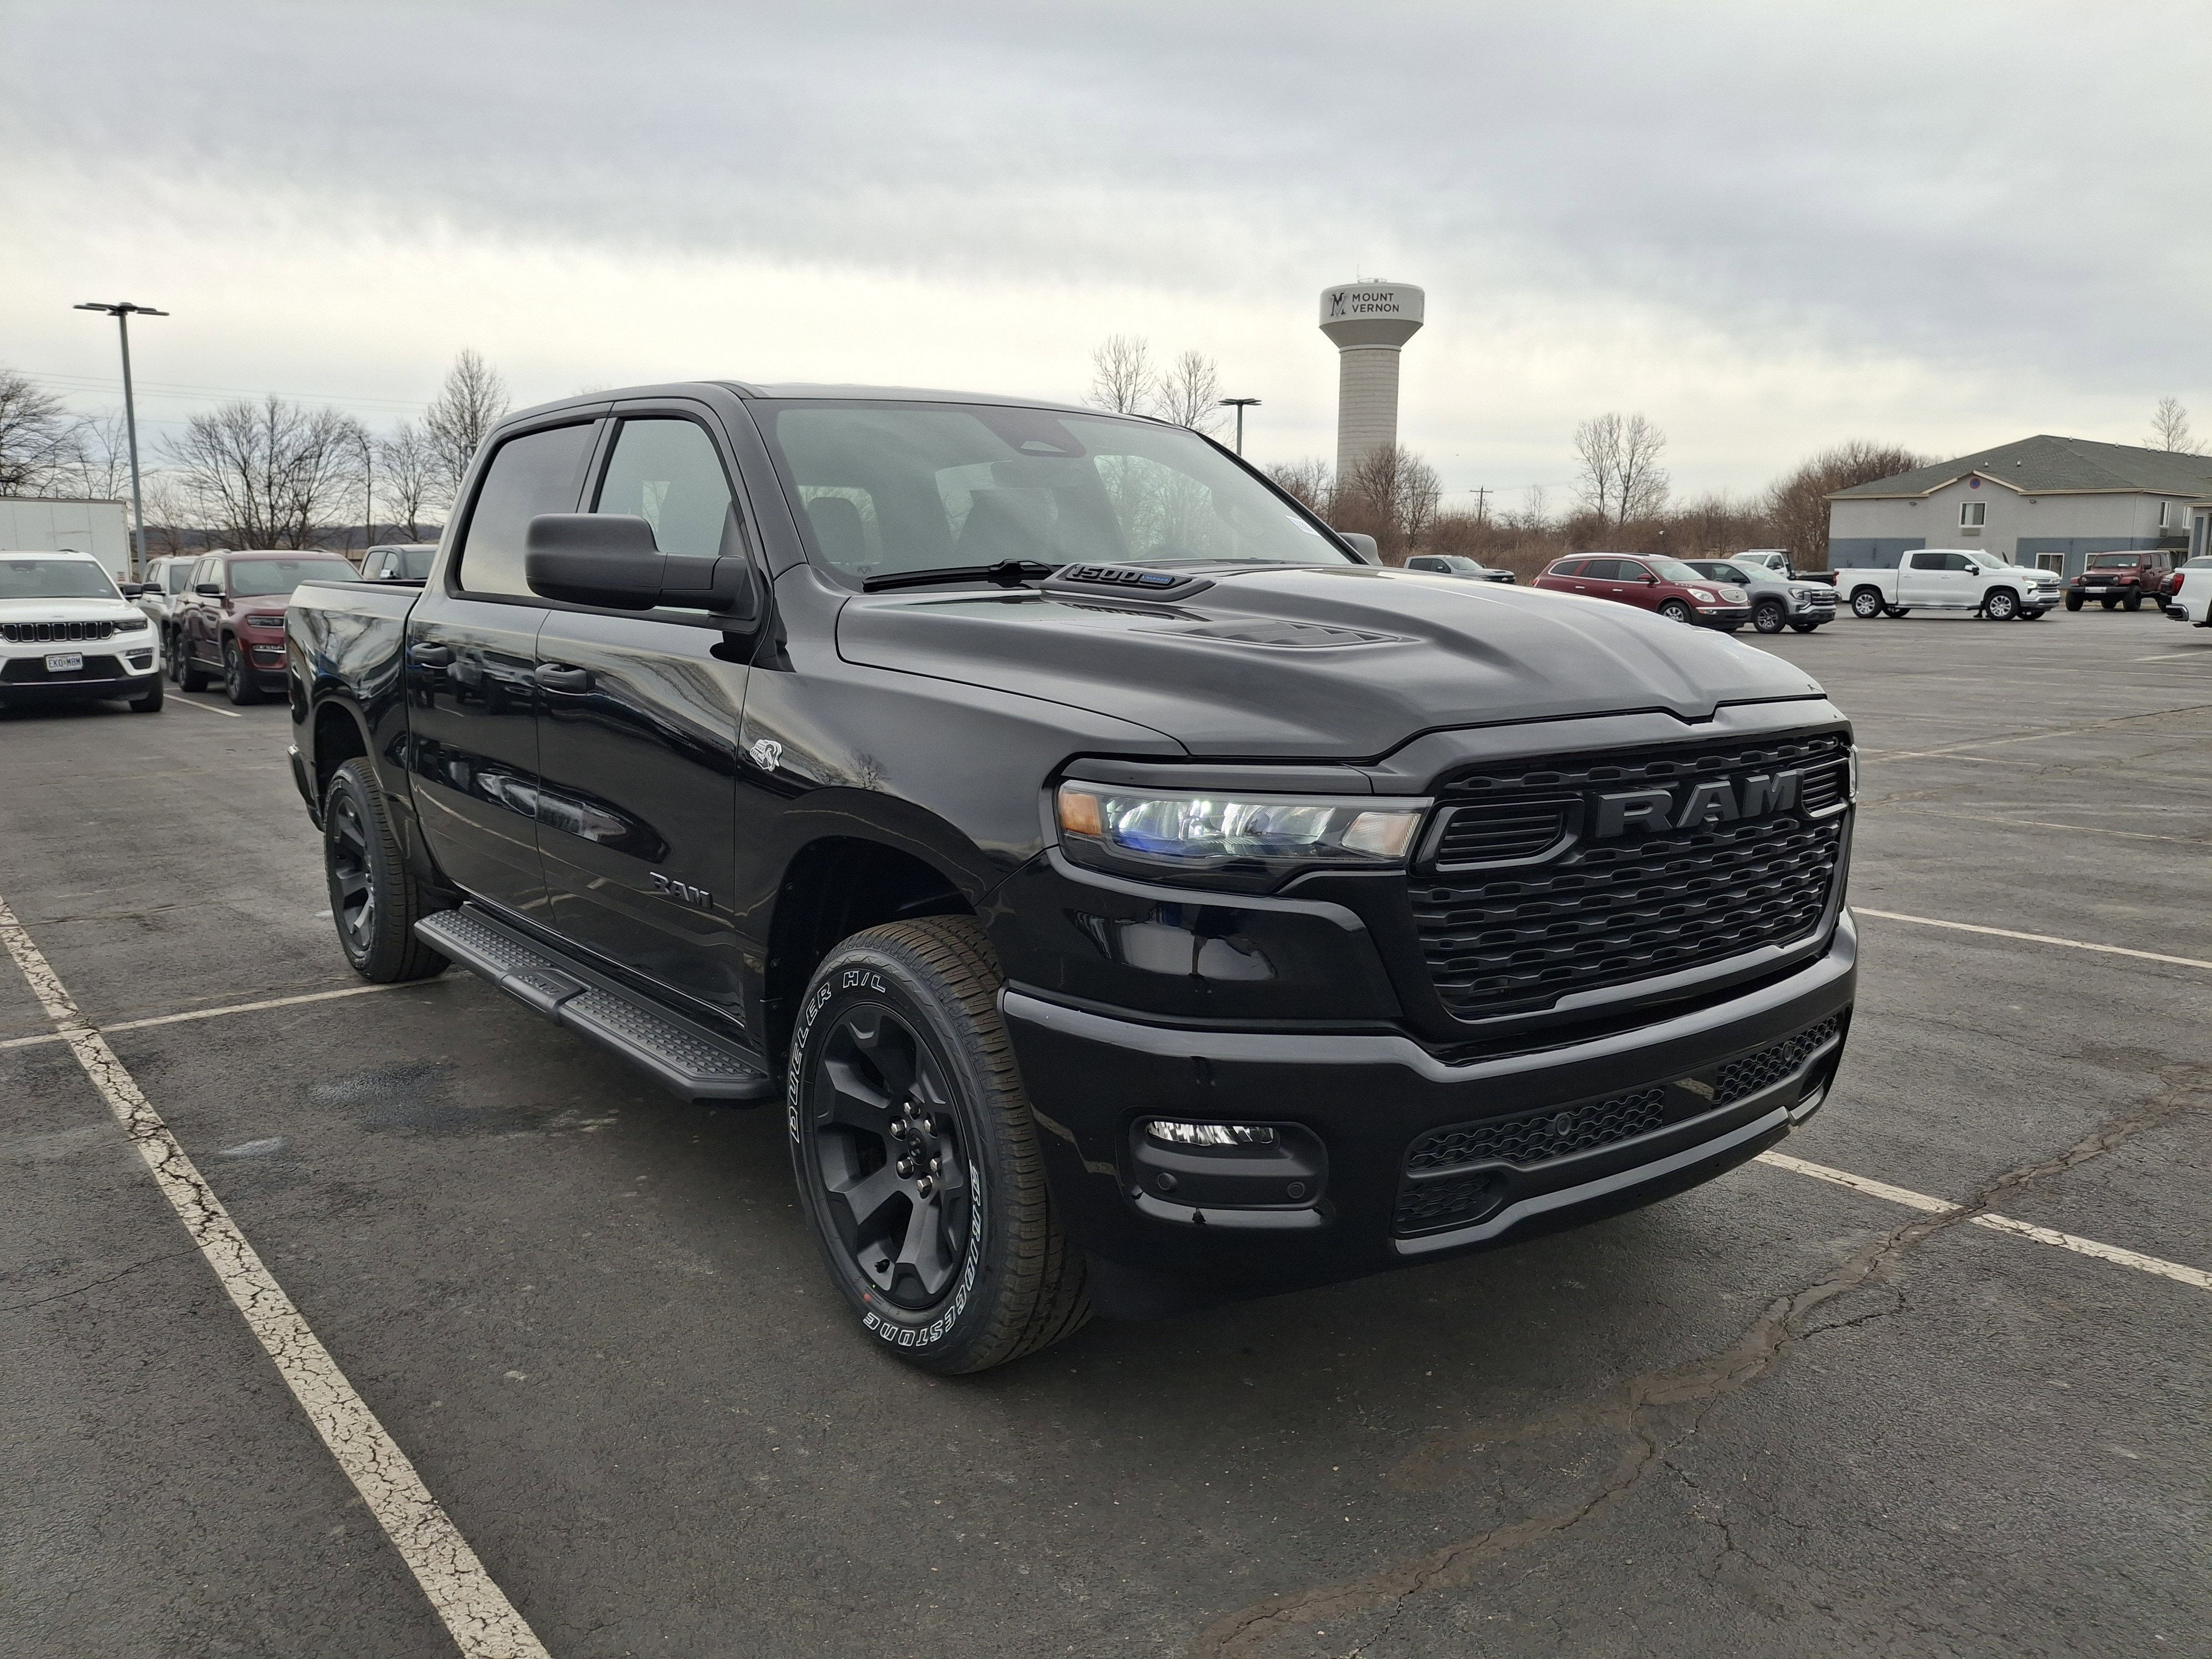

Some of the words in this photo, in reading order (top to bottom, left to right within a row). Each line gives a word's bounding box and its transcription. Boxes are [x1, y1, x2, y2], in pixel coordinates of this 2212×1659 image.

[1352, 293, 1394, 302] MOUNT
[1352, 304, 1399, 313] VERNON
[1072, 566, 1142, 582] 1500
[1596, 769, 1797, 838] RAM
[650, 871, 713, 909] RAM
[789, 981, 832, 1144] DUELER
[843, 970, 886, 993] H/L
[863, 1159, 981, 1347] BRIDGESTONE
